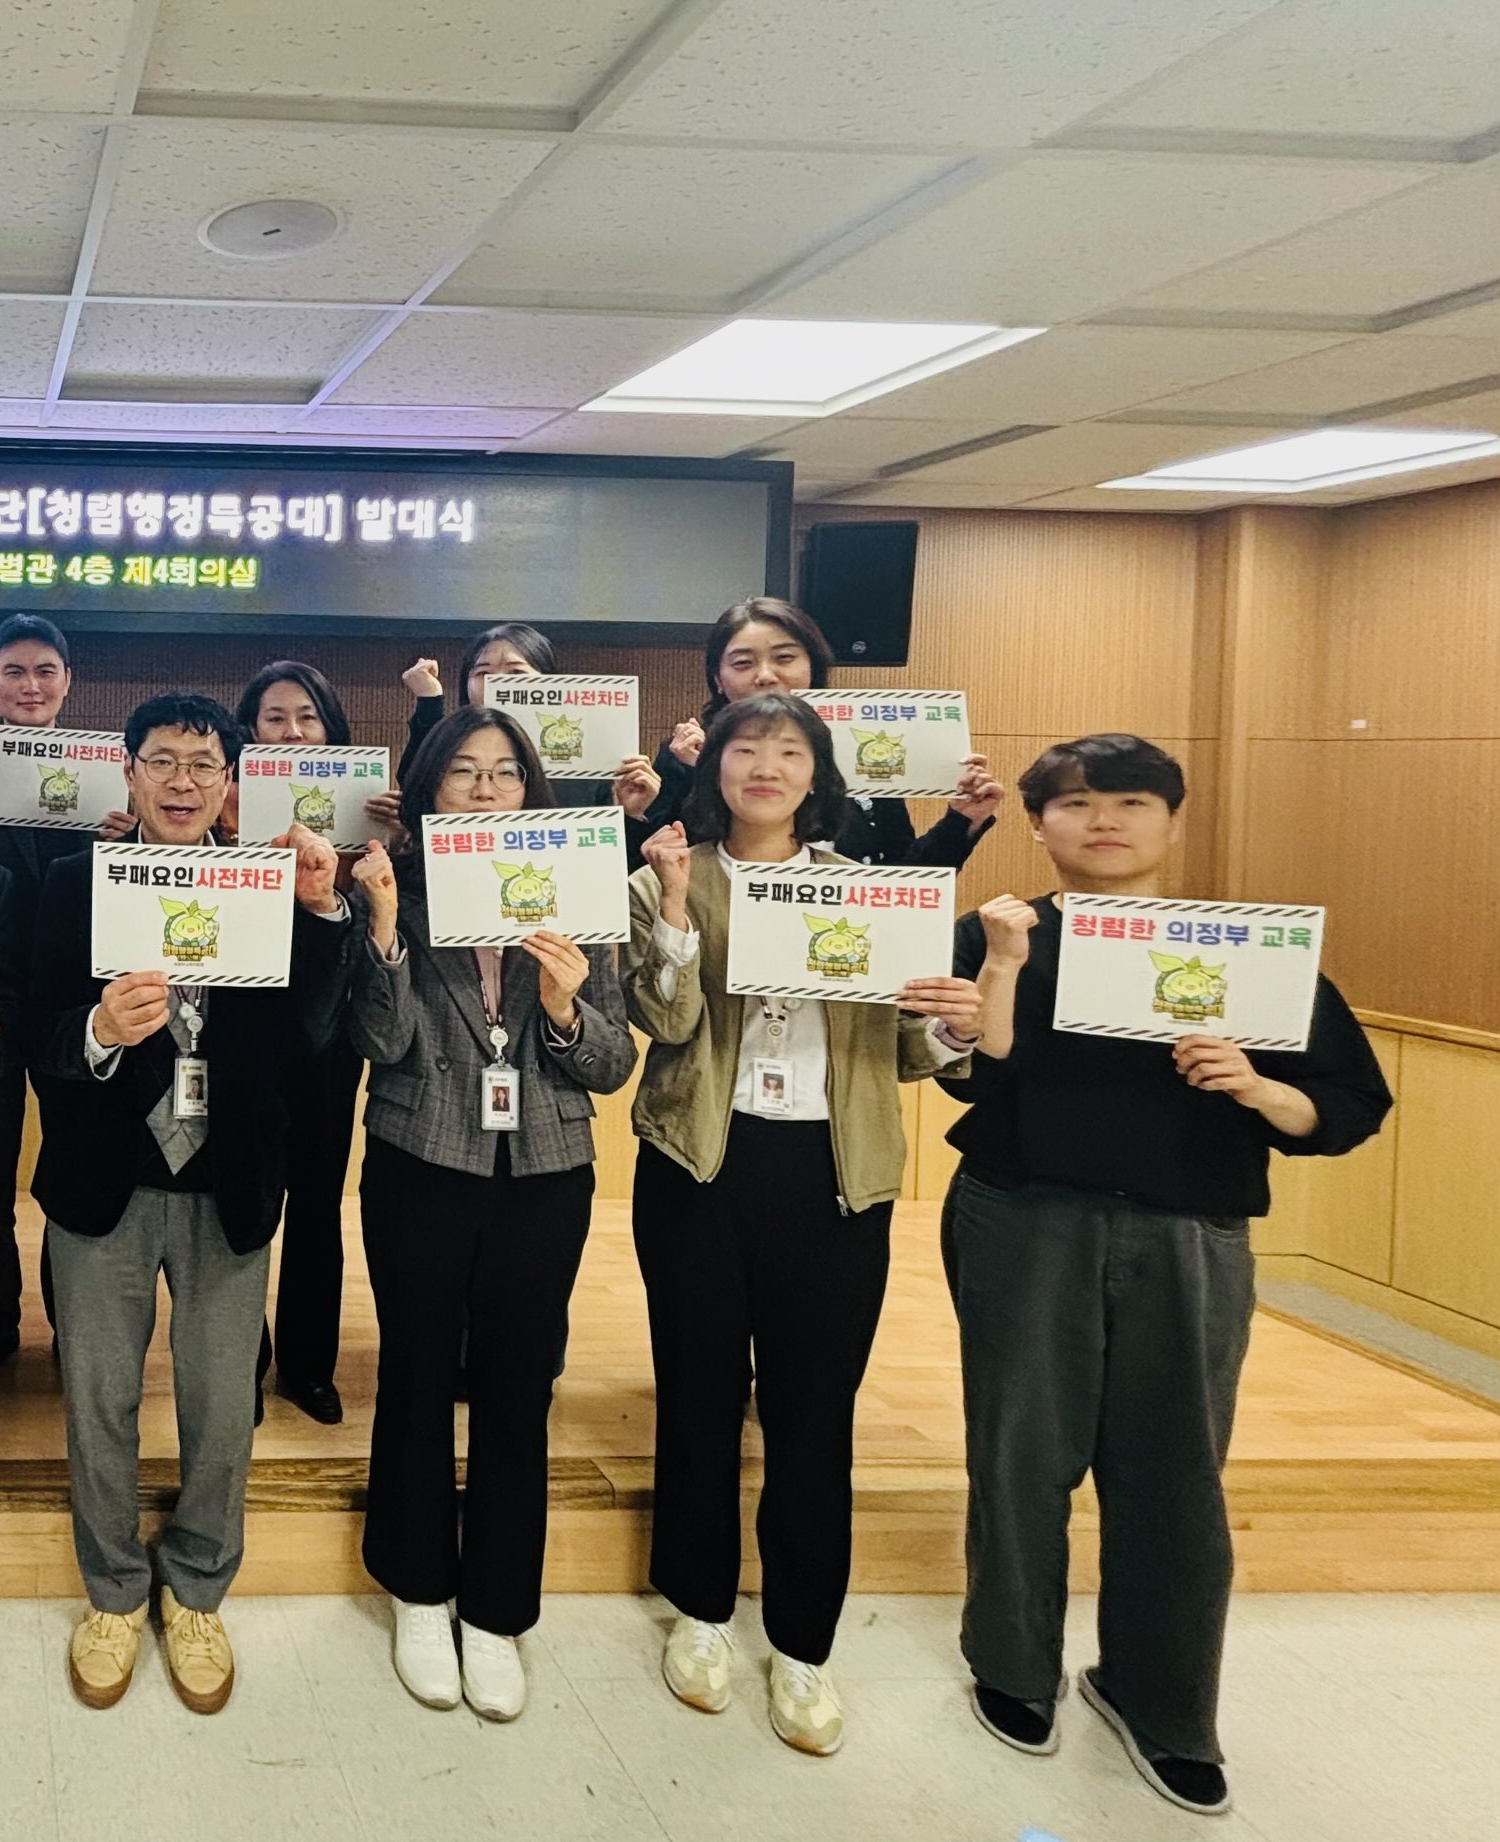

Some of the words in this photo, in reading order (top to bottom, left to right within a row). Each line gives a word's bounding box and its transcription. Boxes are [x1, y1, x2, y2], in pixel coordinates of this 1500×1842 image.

[357, 497, 475, 544] 발대식
[65, 555, 115, 585] 4층
[122, 556, 257, 589] 제4회의실
[811, 704, 853, 721] 렴한
[861, 704, 917, 722] 의정부
[924, 705, 961, 723] 교육
[244, 759, 293, 777] 청렴한
[298, 760, 347, 778] 의정부
[353, 762, 384, 779] 교육
[431, 832, 495, 855] 청렴한
[503, 828, 568, 851] 의정부
[576, 826, 618, 848] 교육
[1071, 914, 1156, 941] 청렴한
[1166, 920, 1250, 947] 의정부
[1260, 925, 1312, 950] 교육
